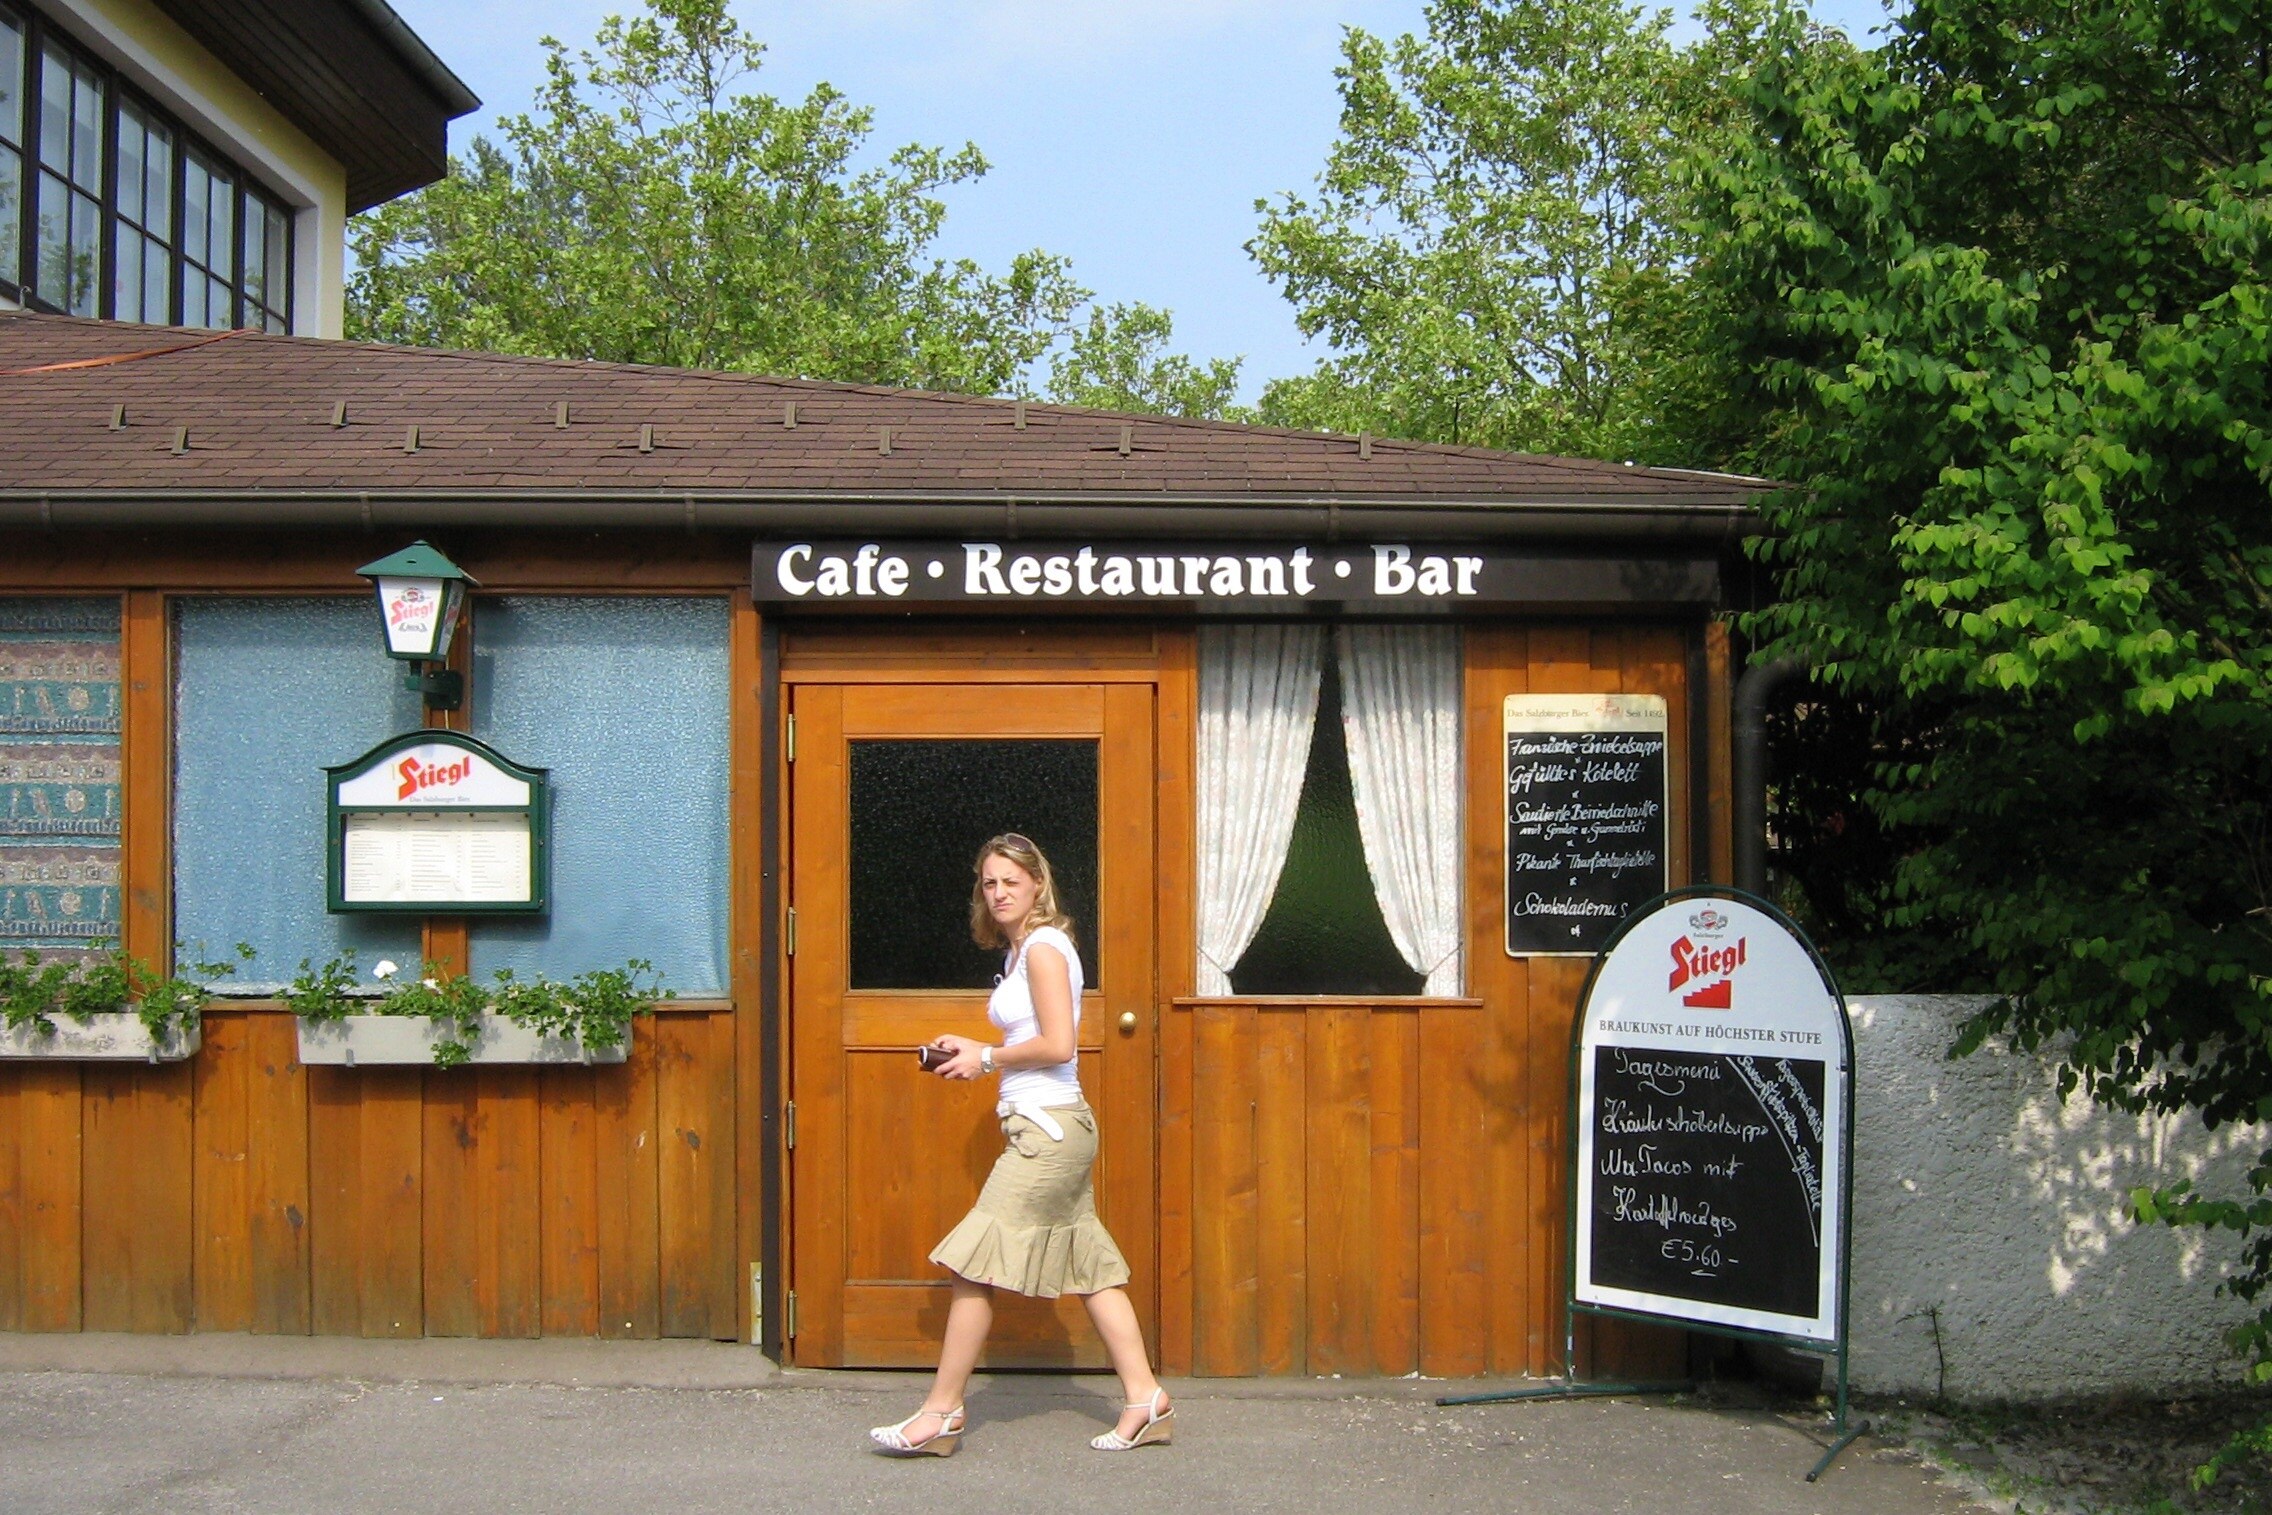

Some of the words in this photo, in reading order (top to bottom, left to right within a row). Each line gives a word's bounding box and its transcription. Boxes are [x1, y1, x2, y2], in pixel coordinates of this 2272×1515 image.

[777, 543, 910, 596] Cafe
[962, 543, 1316, 597] Restaurant
[1370, 544, 1484, 596] Bar
[391, 600, 434, 626] Stiegl
[398, 755, 470, 802] Stiegl
[1669, 934, 1746, 993] Stiegl
[1599, 1020, 1673, 1035] BRAUKUNST
[1675, 1025, 1702, 1037] AUF
[1705, 1025, 1775, 1042] HÖCHSTER
[1779, 1030, 1822, 1045] STUFE
[1703, 1154, 1744, 1179] mit
